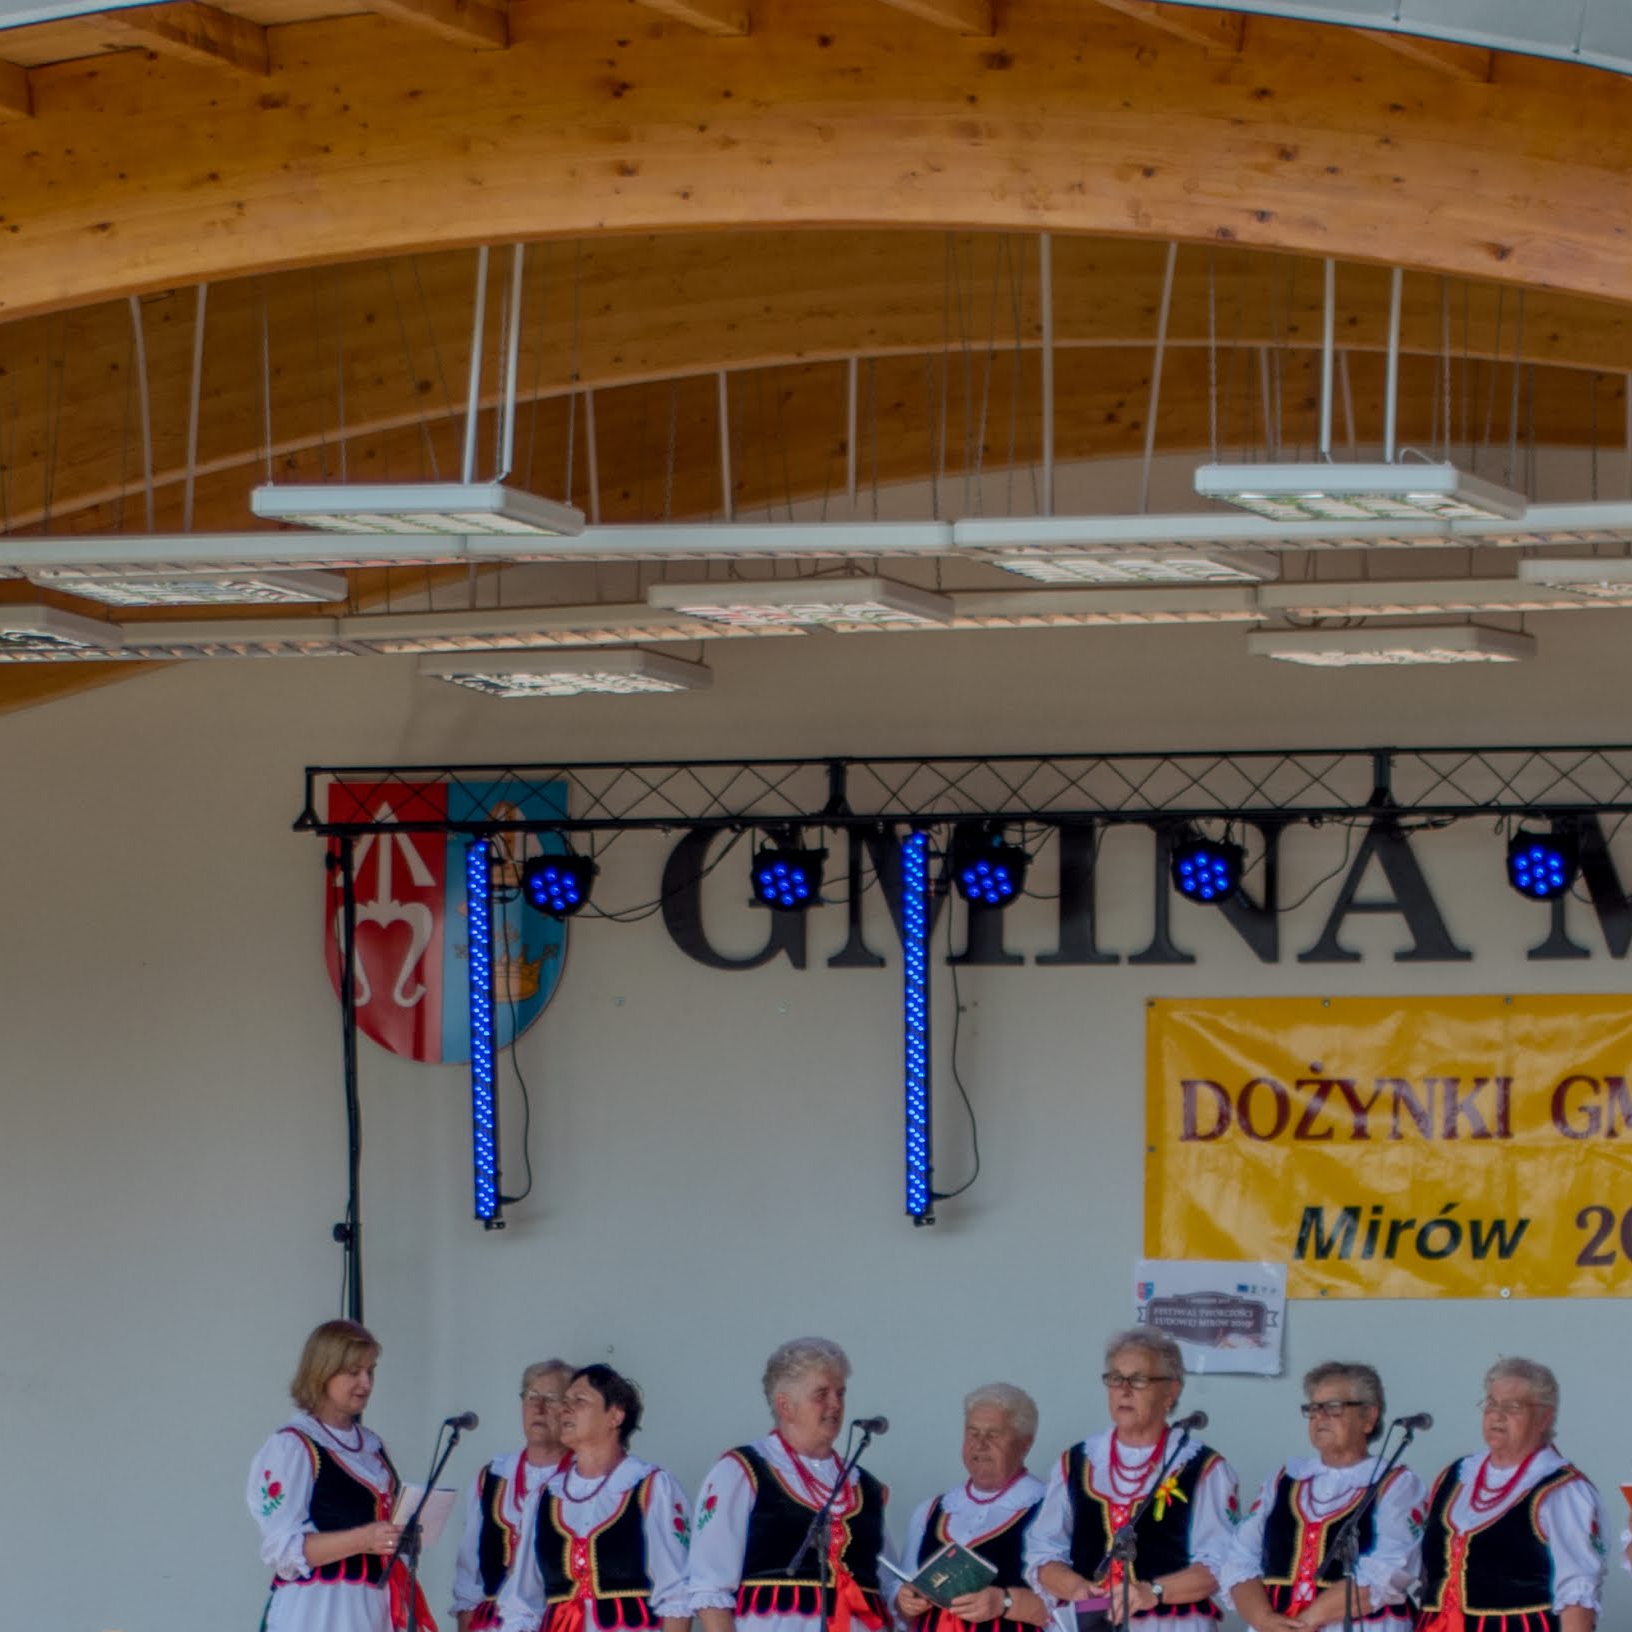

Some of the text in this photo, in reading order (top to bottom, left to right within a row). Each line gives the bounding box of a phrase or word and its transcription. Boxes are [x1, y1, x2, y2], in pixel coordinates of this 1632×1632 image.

[660, 820, 1473, 970] GMINA
[1178, 1060, 1515, 1143] DOŻYNKI
[1292, 1201, 1532, 1262] Mirów
